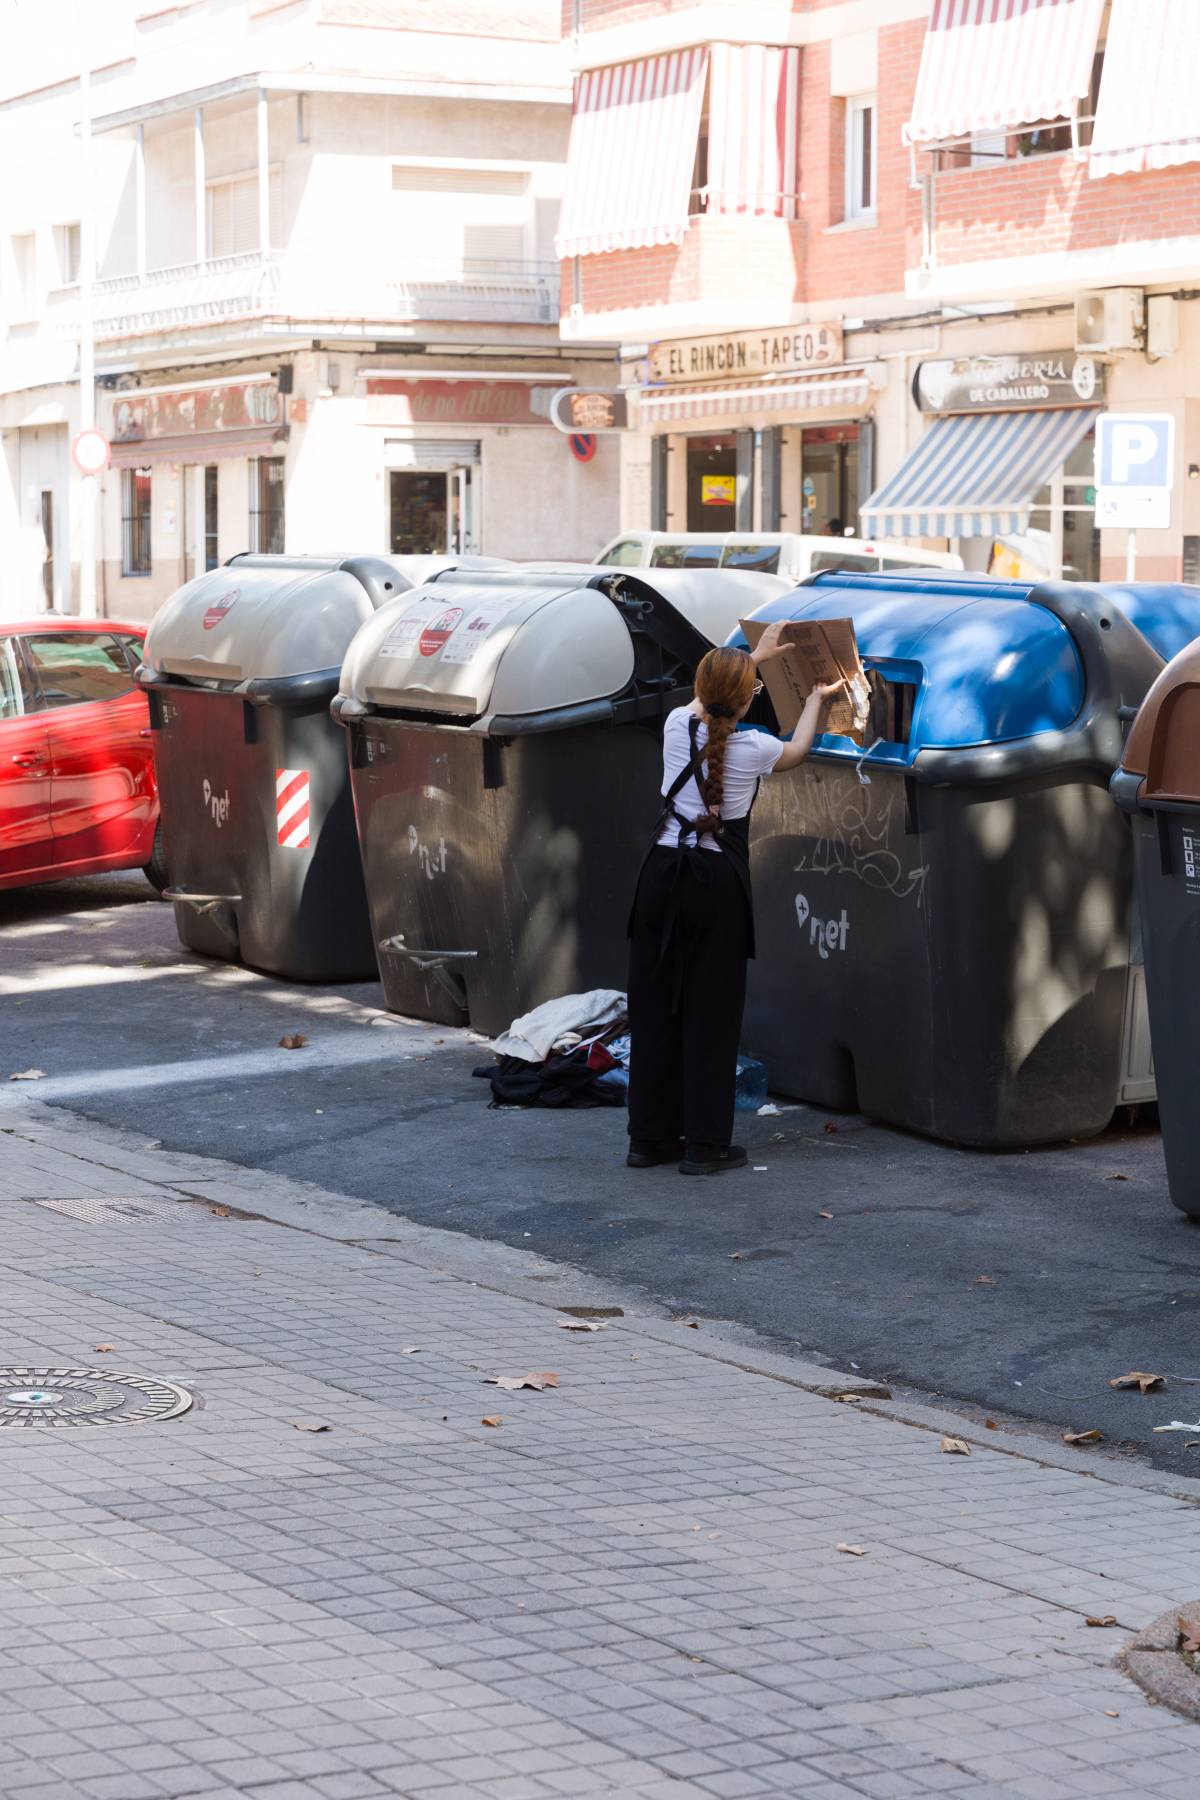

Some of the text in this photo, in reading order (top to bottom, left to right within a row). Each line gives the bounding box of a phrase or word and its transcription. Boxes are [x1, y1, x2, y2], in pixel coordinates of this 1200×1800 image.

[669, 333, 813, 374] EL RINCON TAPEO
[969, 385, 1049, 402] DE CABALLERO
[1111, 424, 1158, 483] P
